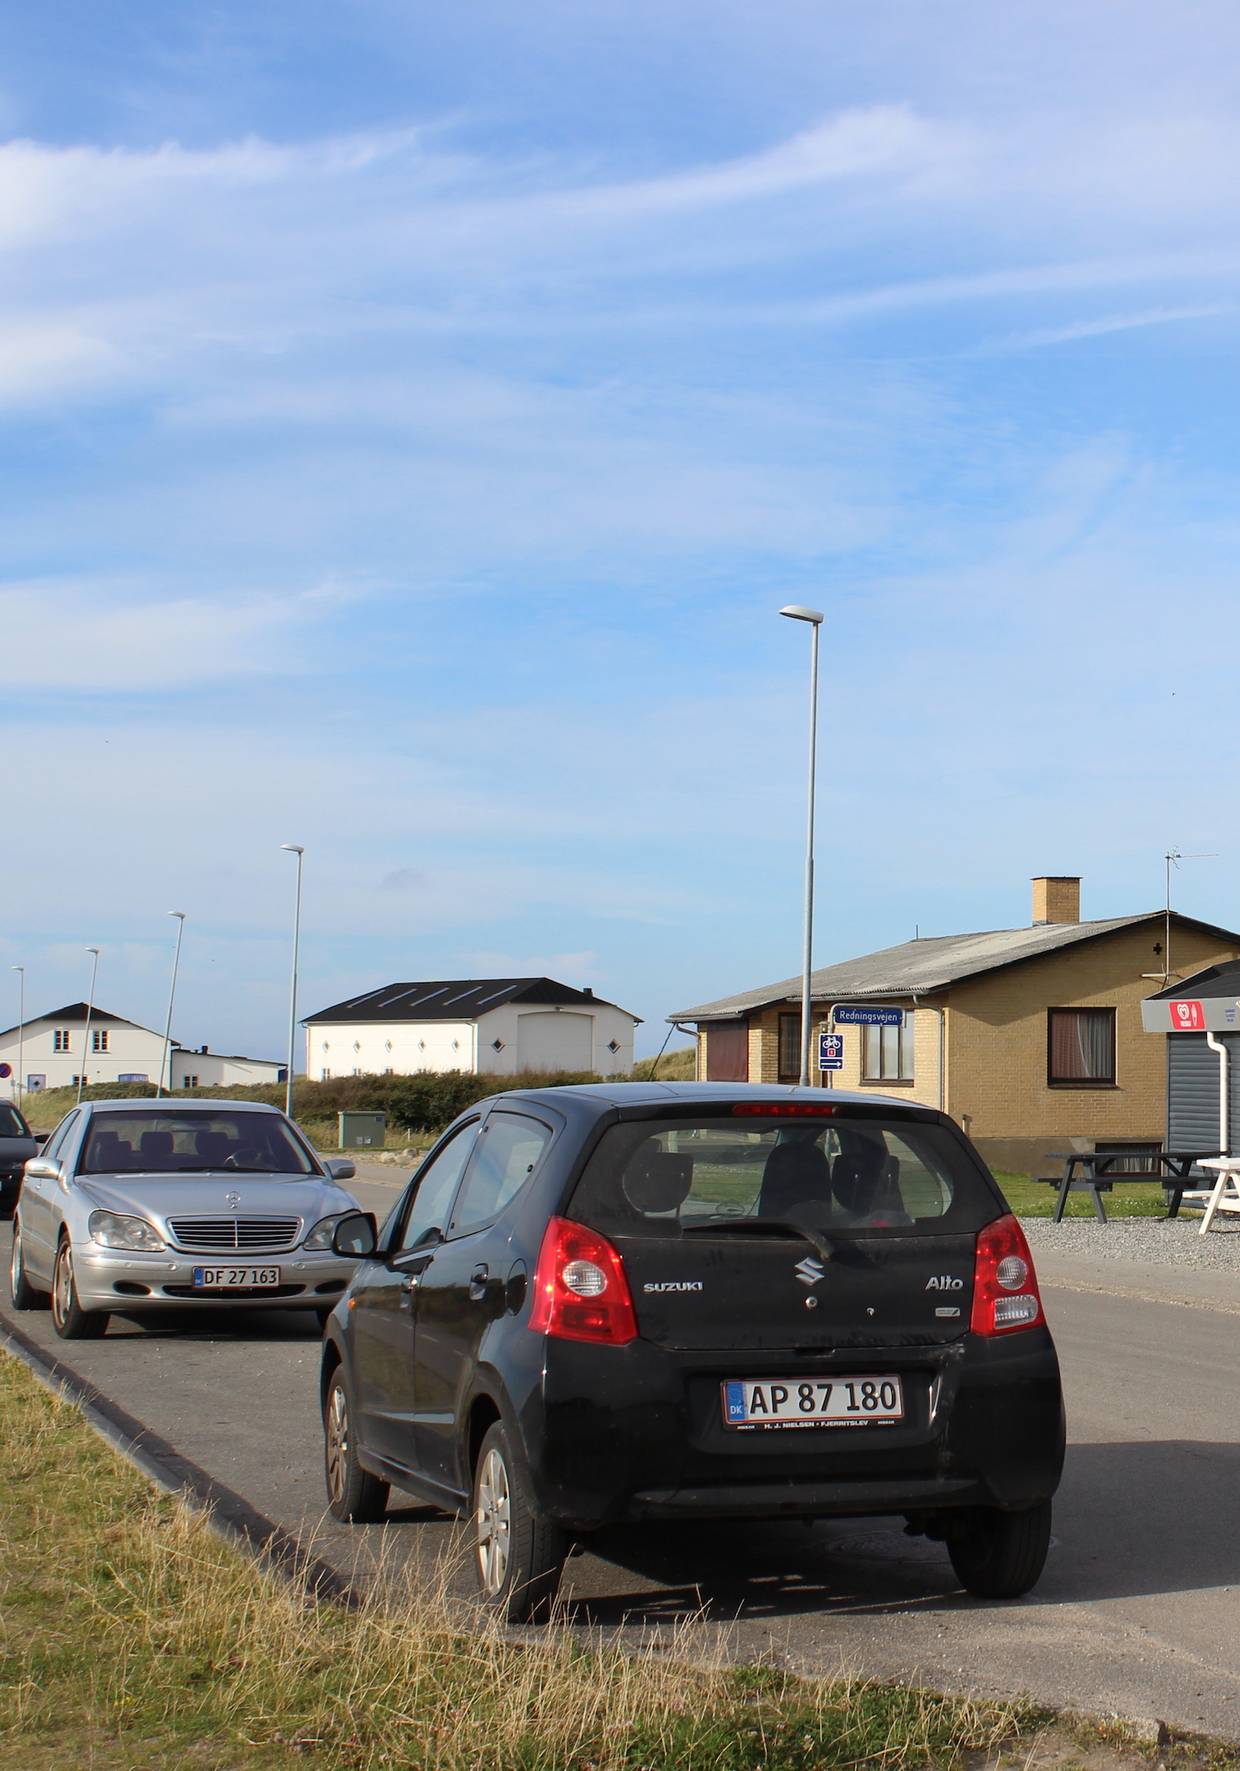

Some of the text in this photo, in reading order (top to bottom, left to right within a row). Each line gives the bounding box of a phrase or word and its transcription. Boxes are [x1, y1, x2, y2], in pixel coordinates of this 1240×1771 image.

[839, 1010, 898, 1024] Redningsvejen
[204, 1270, 224, 1284] DF
[228, 1270, 247, 1284] 27
[252, 1270, 277, 1284] 163
[925, 1275, 964, 1290] Alto
[643, 1281, 703, 1293] SUZUKI
[750, 1381, 897, 1414] AP 87 180
[730, 1405, 743, 1414] DK
